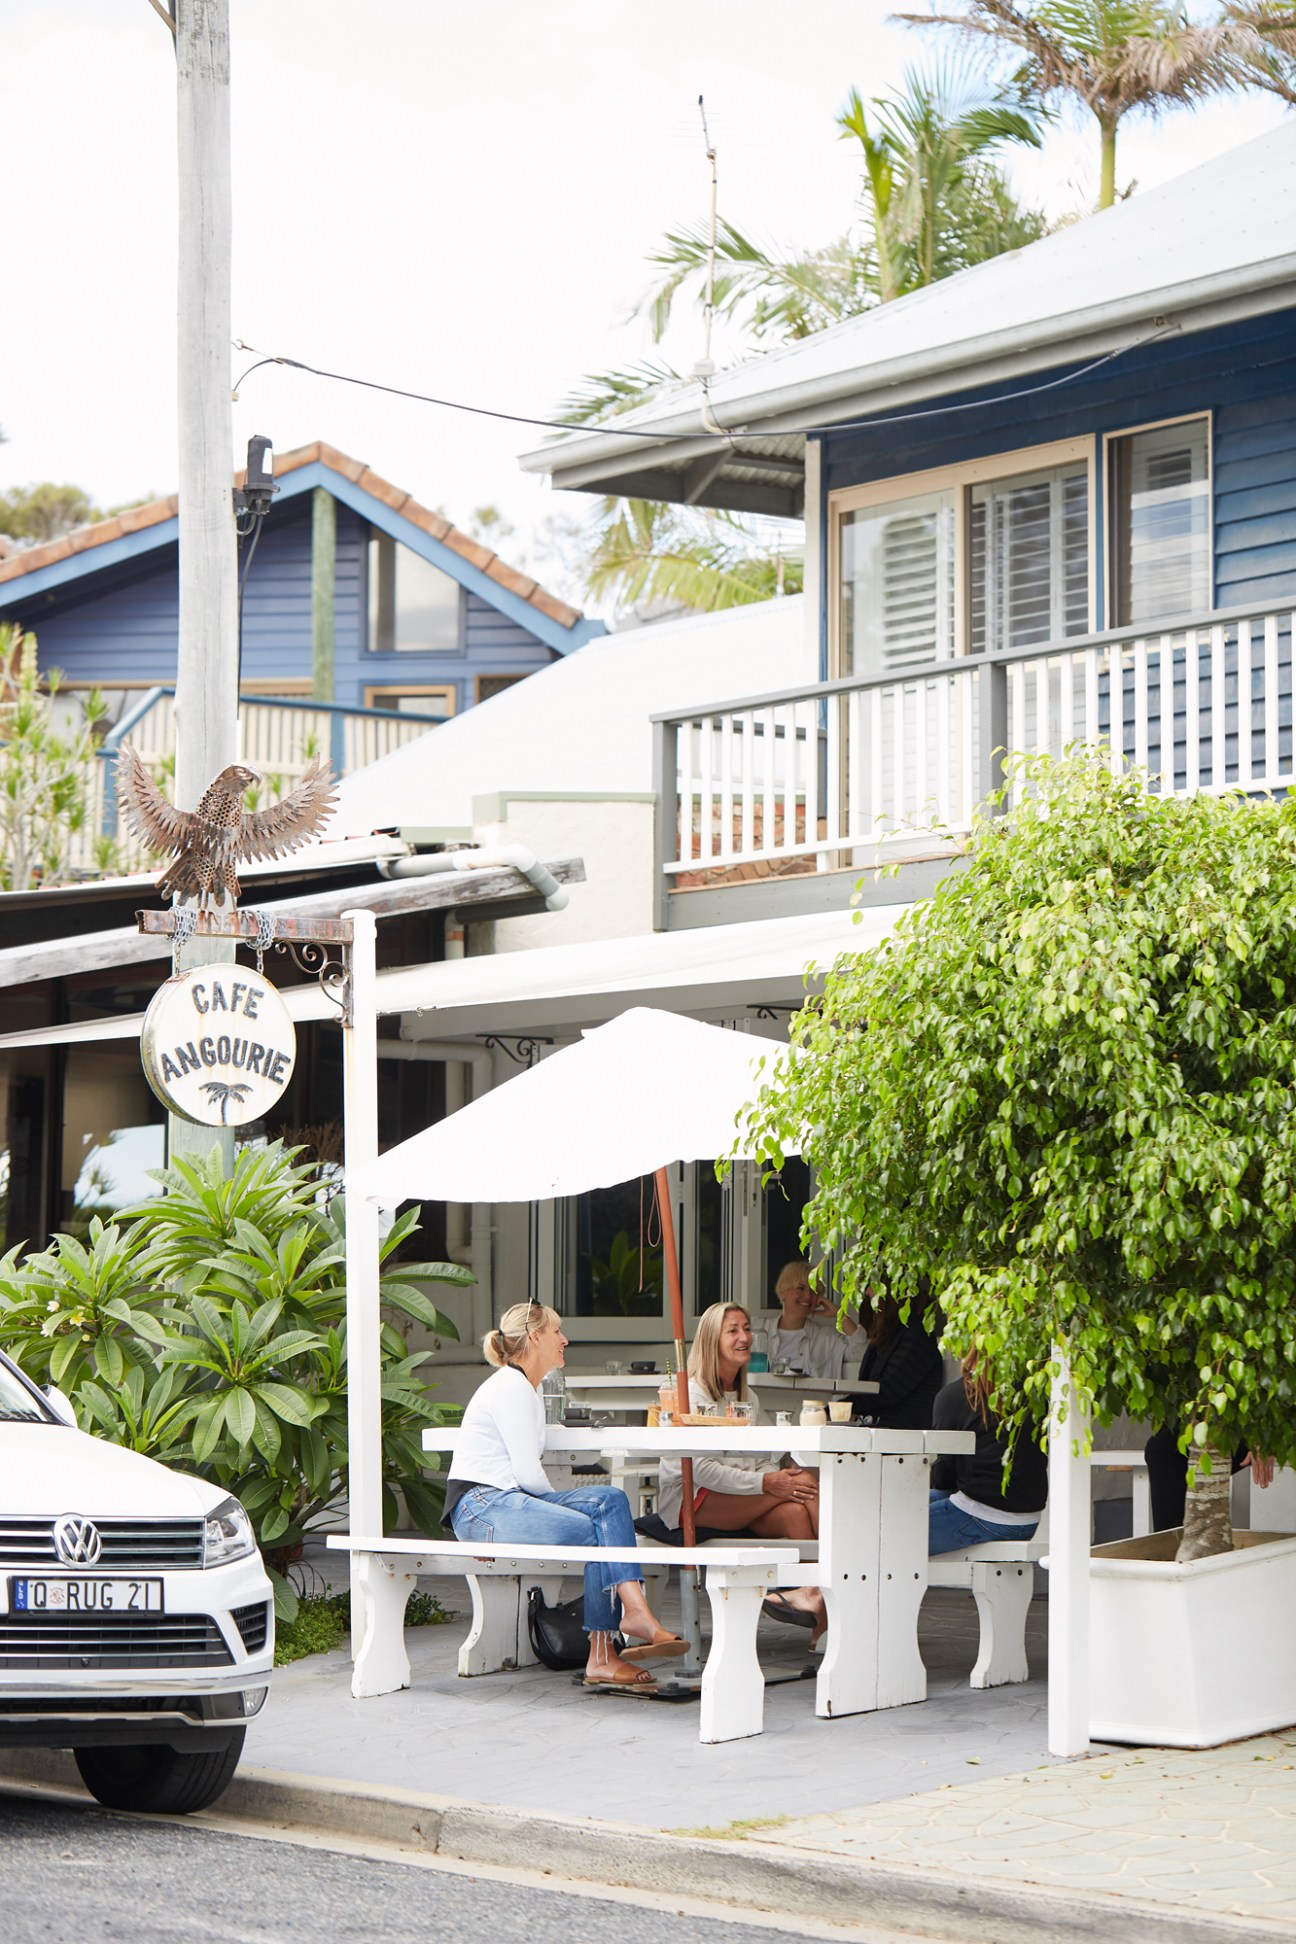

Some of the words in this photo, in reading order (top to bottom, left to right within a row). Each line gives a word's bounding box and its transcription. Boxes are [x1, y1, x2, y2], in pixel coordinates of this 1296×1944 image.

[192, 981, 264, 1019] CAFE
[160, 1035, 291, 1085] ANGOURIE
[67, 1582, 113, 1610] RUG
